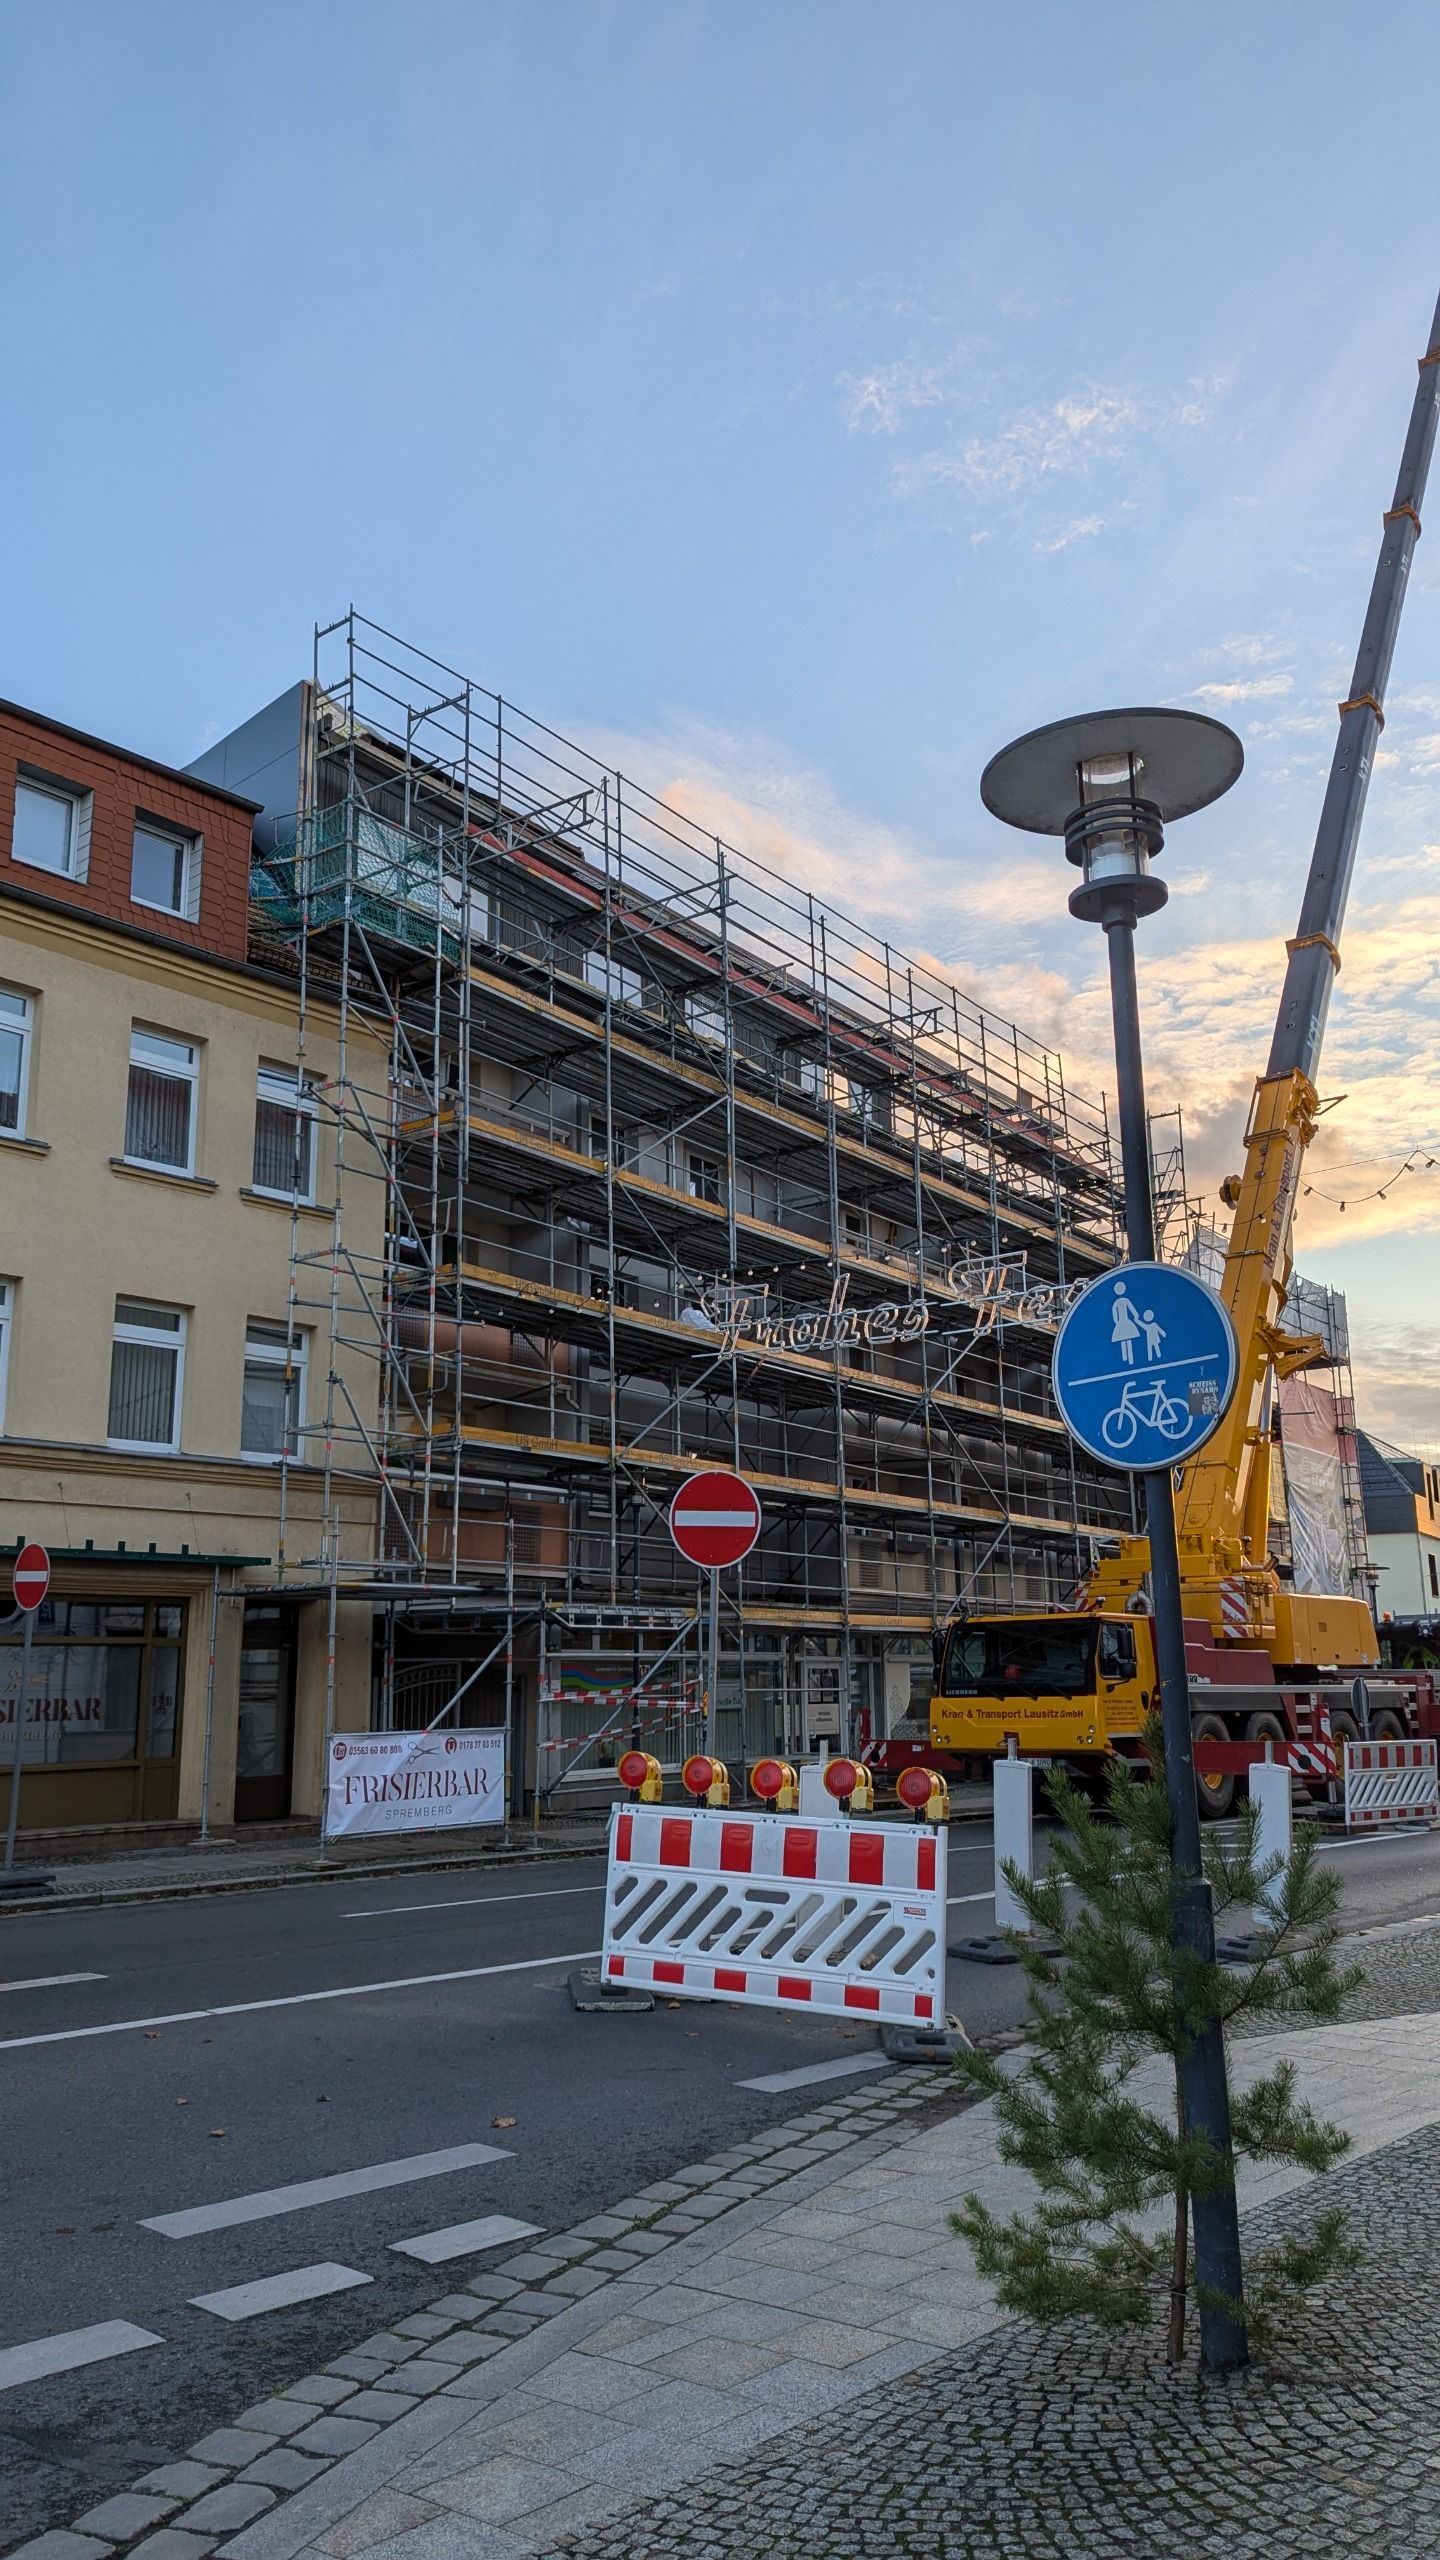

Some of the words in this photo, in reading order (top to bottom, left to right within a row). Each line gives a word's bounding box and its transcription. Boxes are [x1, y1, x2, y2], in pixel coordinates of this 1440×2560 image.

[1273, 1150, 1294, 1216] Transport
[1271, 1218, 1281, 1231] &
[1264, 1234, 1279, 1270] Kran
[532, 1436, 558, 1450] GmbH
[942, 1709, 964, 1719] Kran
[966, 1709, 973, 1718] &
[976, 1709, 1021, 1720] Transport
[1024, 1708, 1059, 1719] Lausitz
[1060, 1710, 1083, 1718] GmbH
[349, 1746, 369, 1755] 03563
[370, 1746, 378, 1755] 60
[380, 1745, 388, 1754] 80
[459, 1741, 473, 1749] 0178
[474, 1740, 481, 1749] 27
[482, 1740, 490, 1748] 03
[491, 1739, 501, 1748] 512
[345, 1767, 489, 1805] FRISIERBAR
[385, 1805, 453, 1820] SPREMBERG
